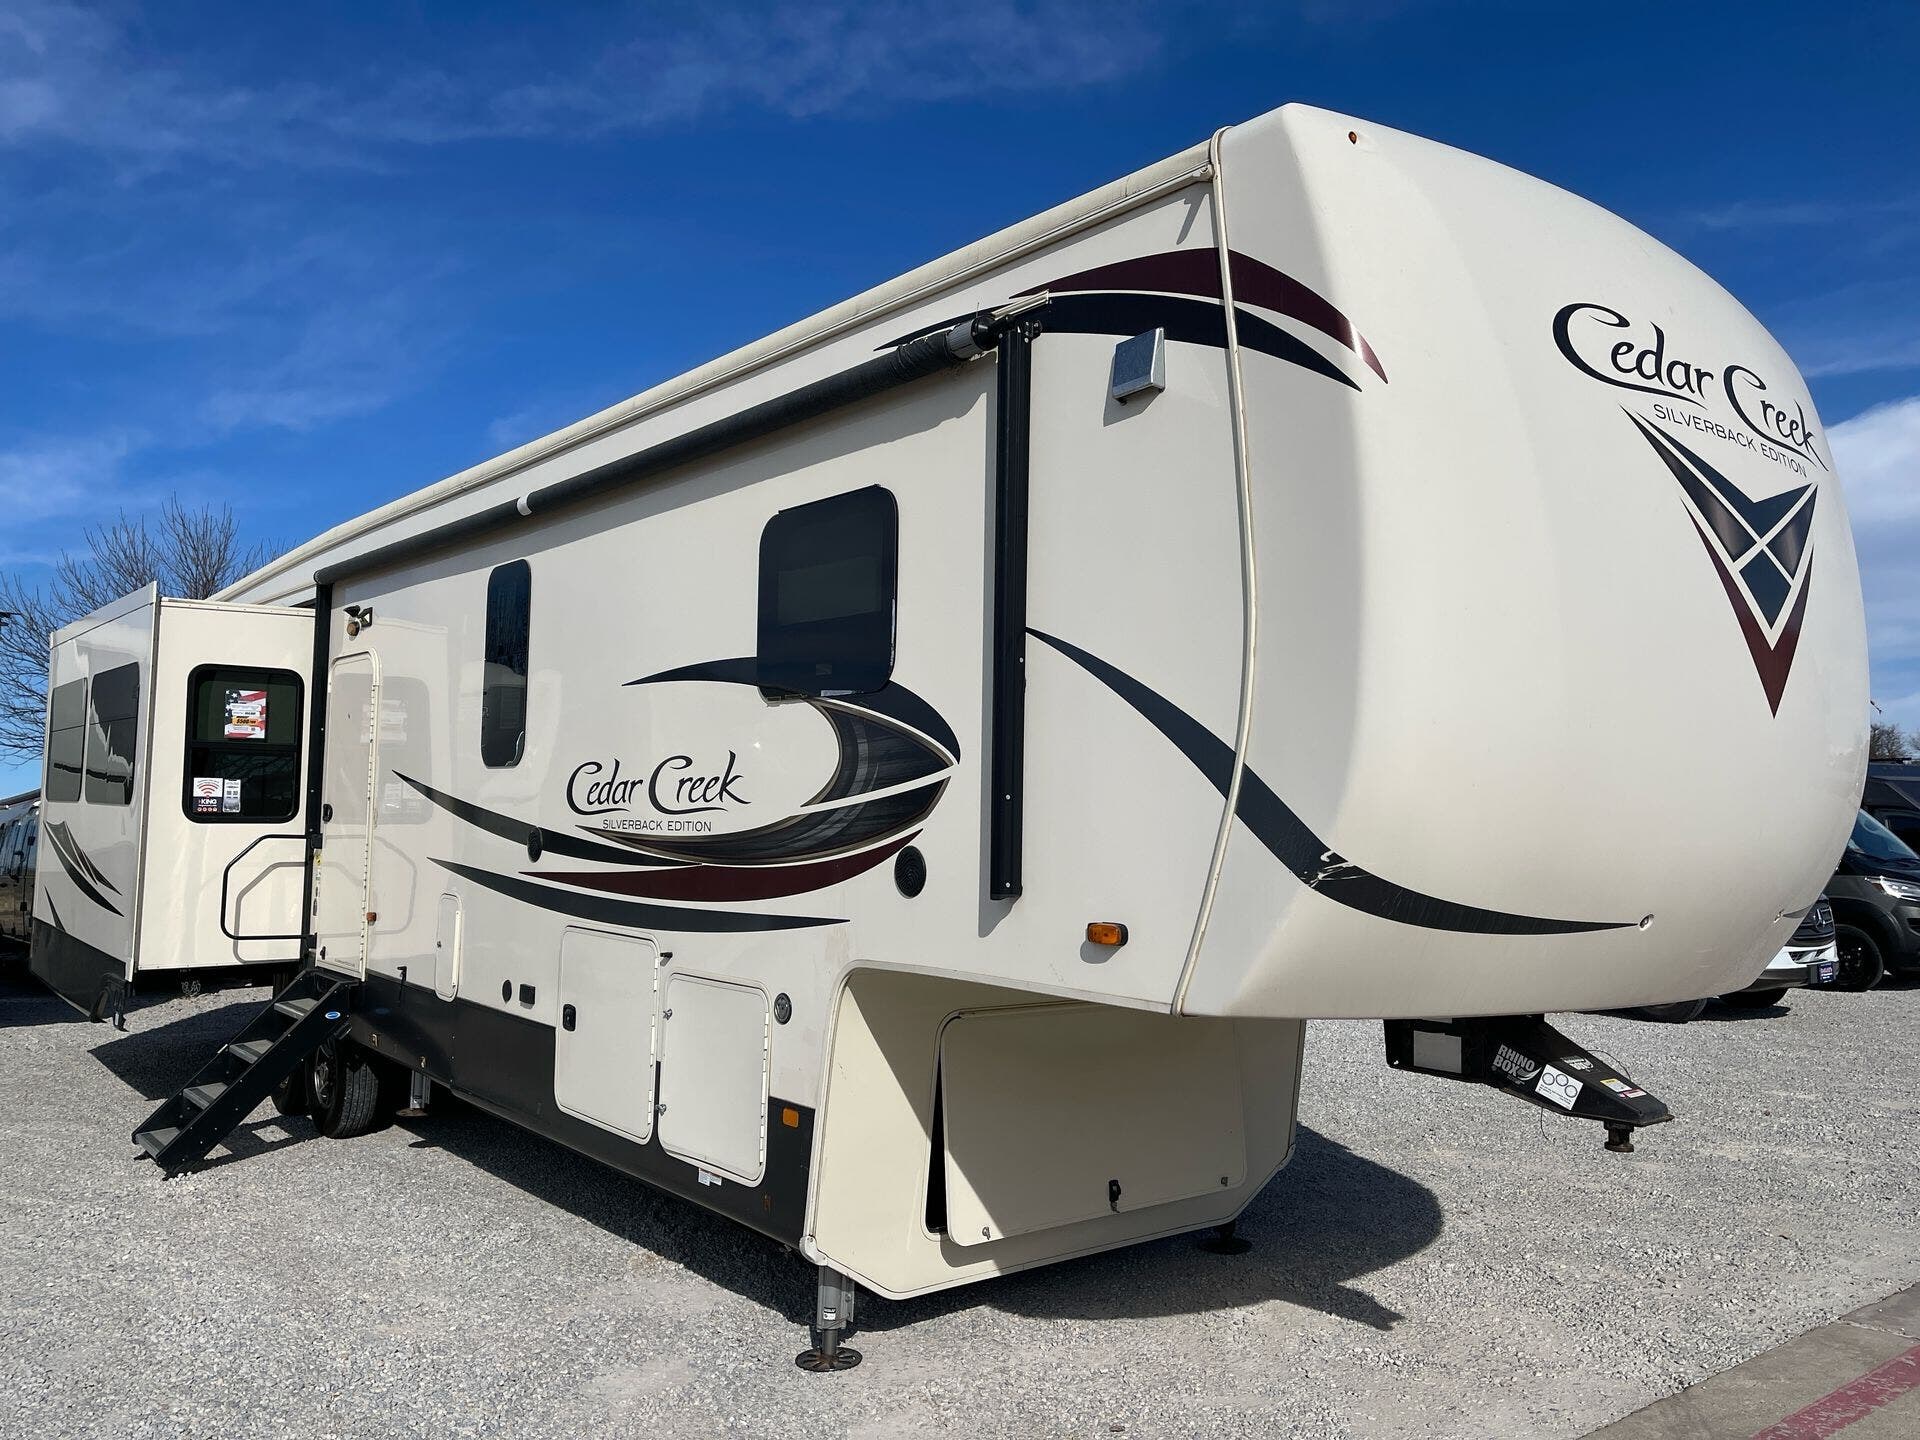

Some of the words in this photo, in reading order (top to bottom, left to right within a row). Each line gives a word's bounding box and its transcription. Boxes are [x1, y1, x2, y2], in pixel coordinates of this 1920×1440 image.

[1552, 302, 1714, 410] Cedar
[1723, 364, 1829, 471] Creek
[1653, 403, 1757, 453] SILVERBACK
[1760, 442, 1808, 478] EDITION
[566, 758, 644, 815] Cedar
[648, 749, 752, 815] Creek
[602, 819, 663, 831] SILVERBACK
[667, 820, 712, 832] EDITION
[1492, 1054, 1520, 1076] BOX
[1497, 1043, 1535, 1071] RHINO
